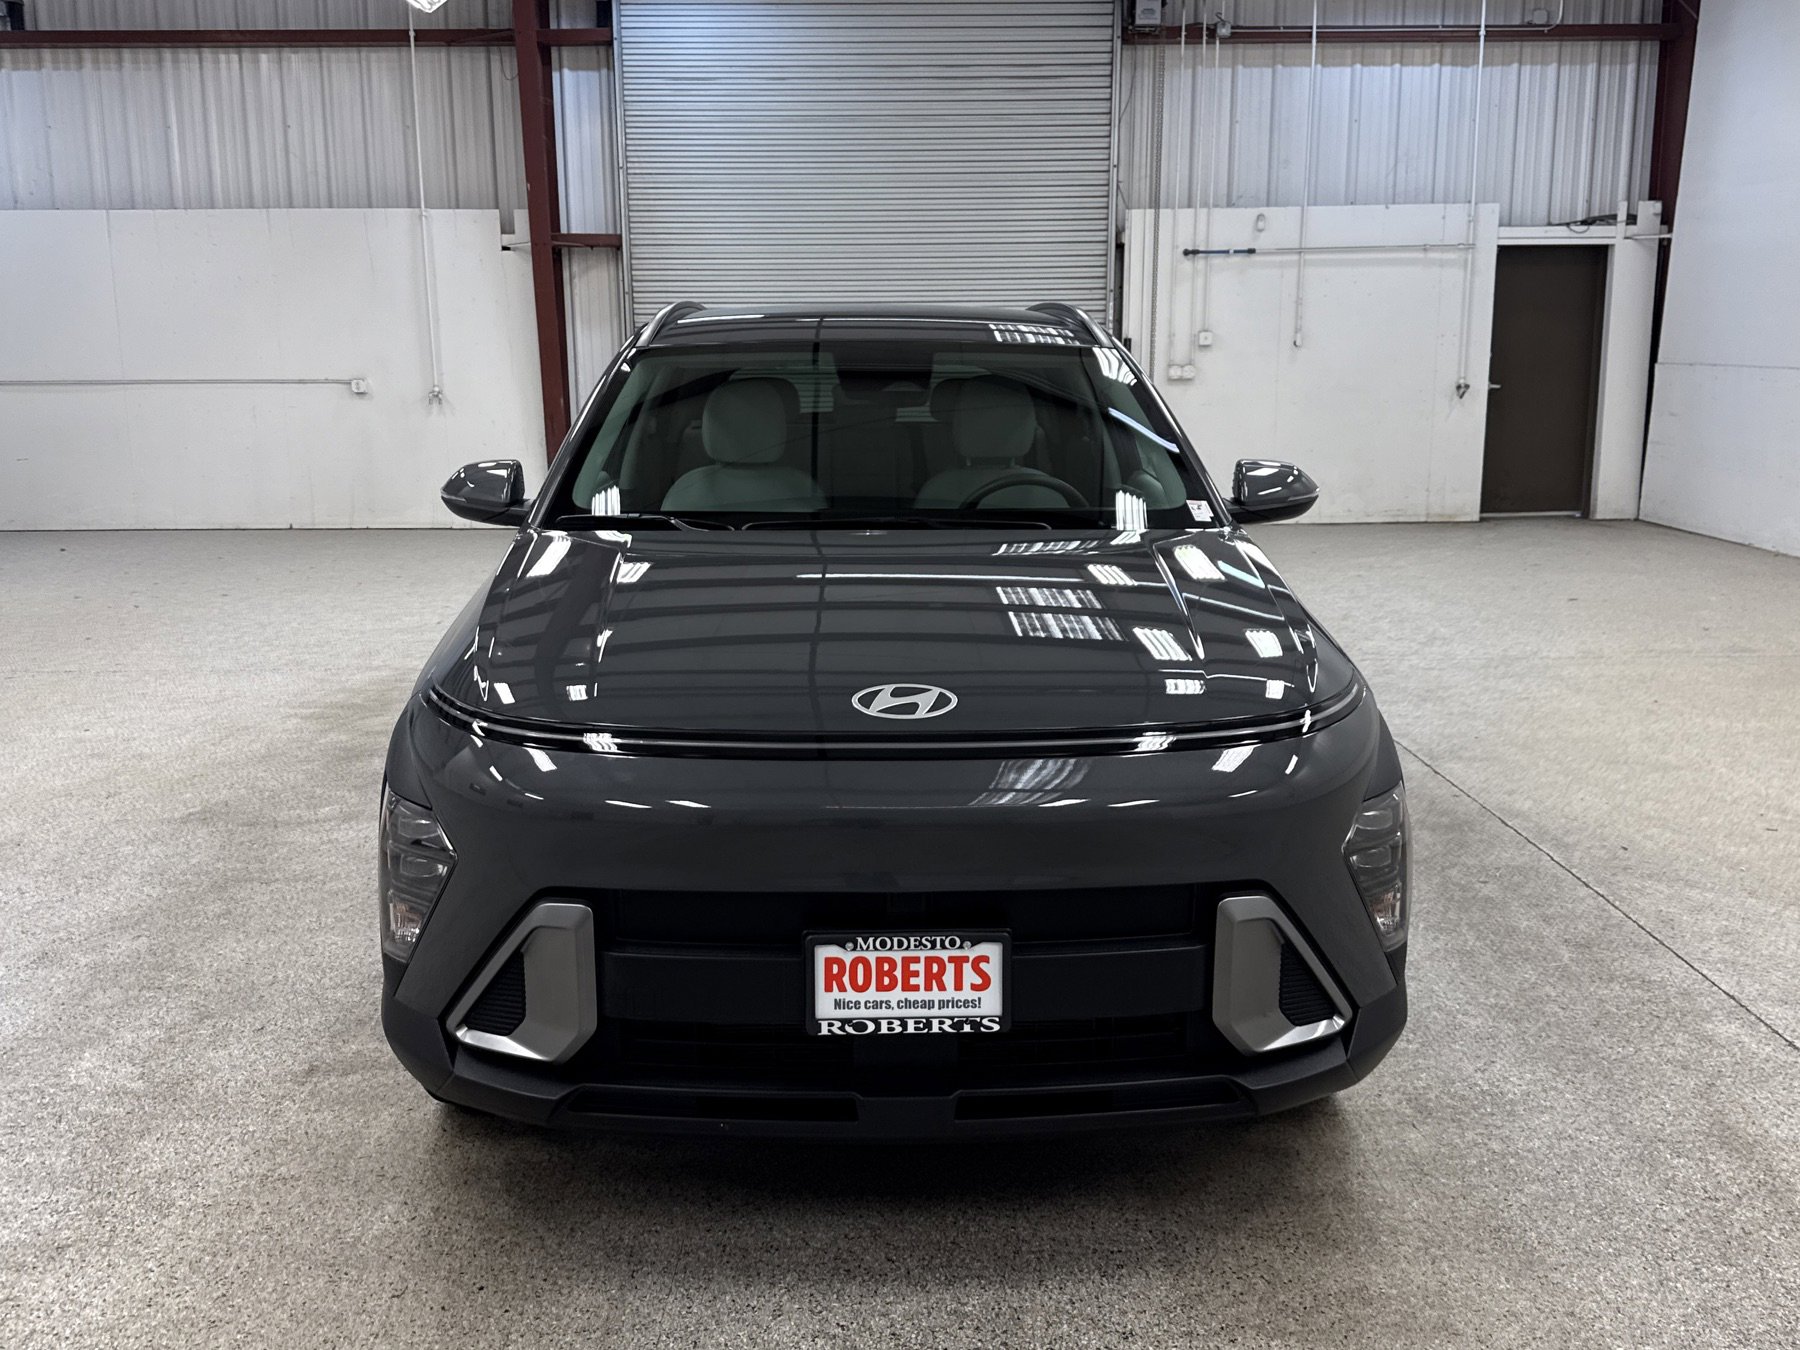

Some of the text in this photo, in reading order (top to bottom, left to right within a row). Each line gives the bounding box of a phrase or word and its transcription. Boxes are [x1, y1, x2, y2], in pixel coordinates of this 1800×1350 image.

[855, 936, 961, 951] MODESTO
[824, 955, 992, 993] ROBERTS
[833, 996, 982, 1011] Nice cars, cheap prices!
[818, 1017, 1001, 1035] ROBERTS
